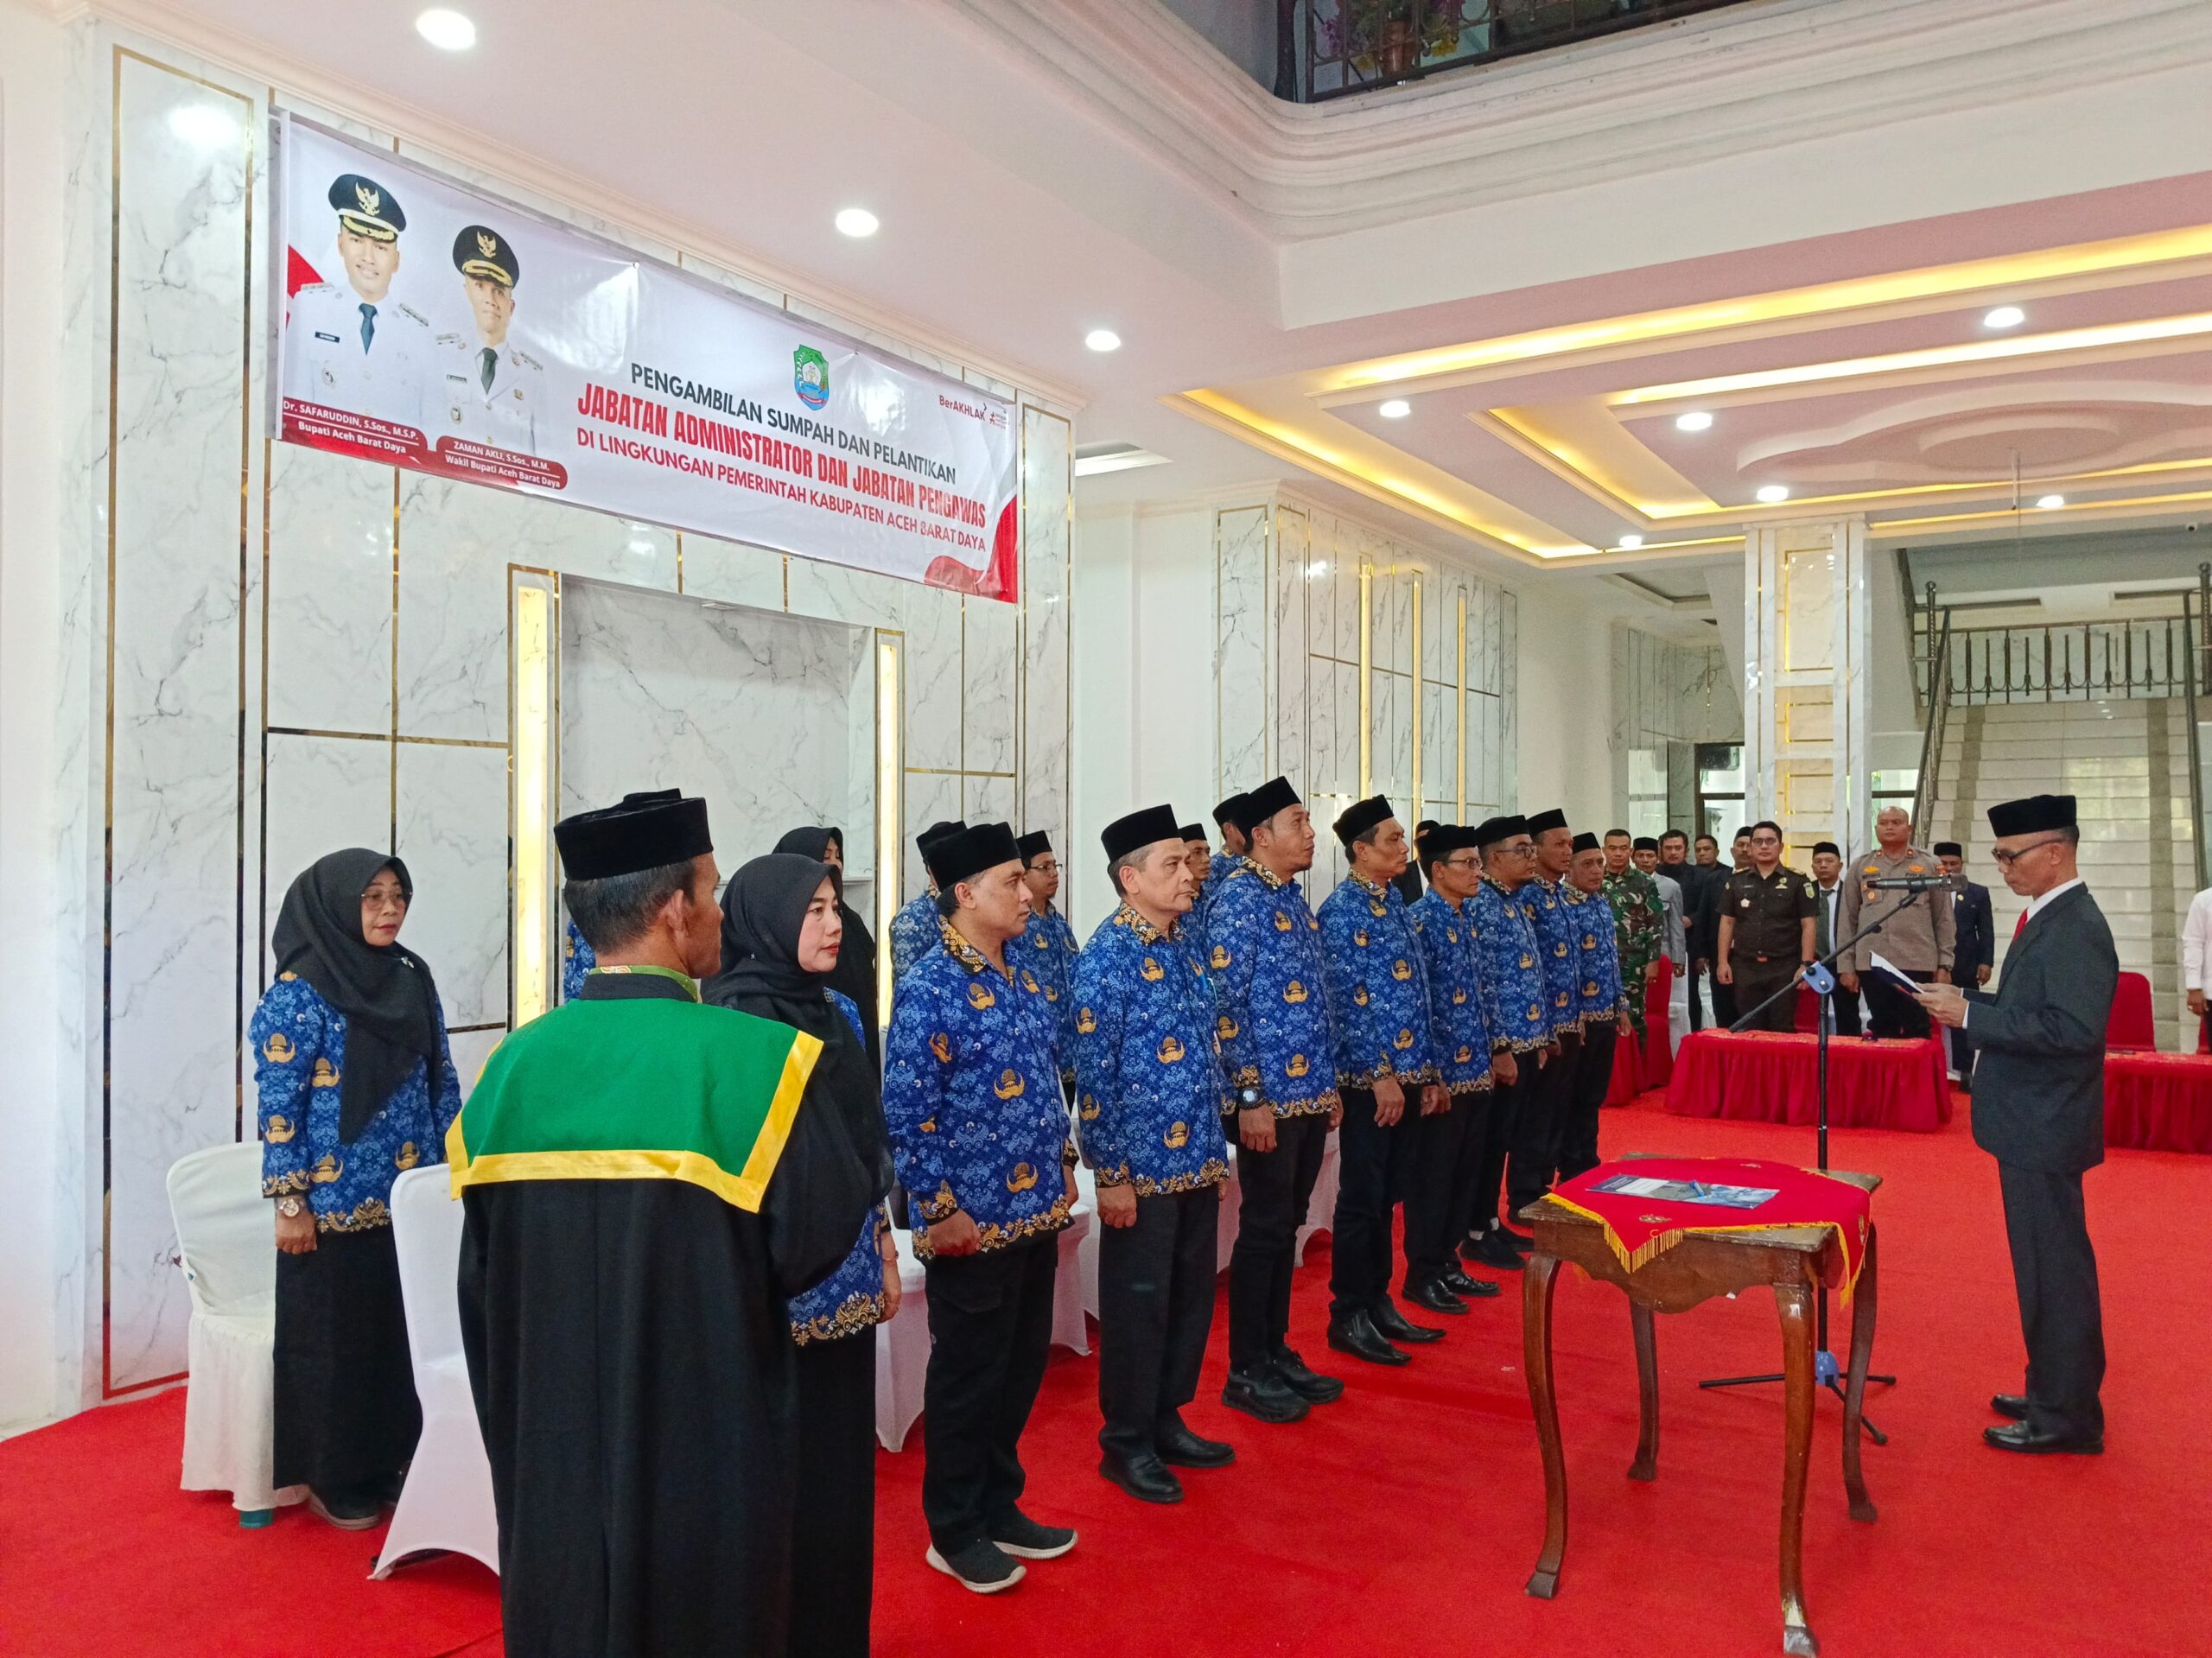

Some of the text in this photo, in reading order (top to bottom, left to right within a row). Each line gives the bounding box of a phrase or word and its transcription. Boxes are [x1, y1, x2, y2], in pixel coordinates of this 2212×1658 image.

[283, 400, 297, 412] Dr.
[300, 404, 362, 429] SAFARUDDIN,
[392, 427, 418, 440] M.S.P.
[632, 362, 956, 485] PENGAMBILAN SUMPAH DAN PELANTIKAN
[939, 395, 985, 421] BerAKHLAK
[298, 421, 406, 454] Bupati Aceh Barat Daya
[454, 441, 483, 455] ZAMAN
[531, 460, 550, 471] M.M.
[578, 383, 986, 529] JABATAN ADMINISTRATOR DAN JABATAN PENGAWAS
[445, 454, 561, 488] Wakil Bupati Aceh Barat Daya
[577, 427, 986, 552] DI LINGKUNGAN PEMERINTAH KABUPATEN ACEH BARAT DAYA
